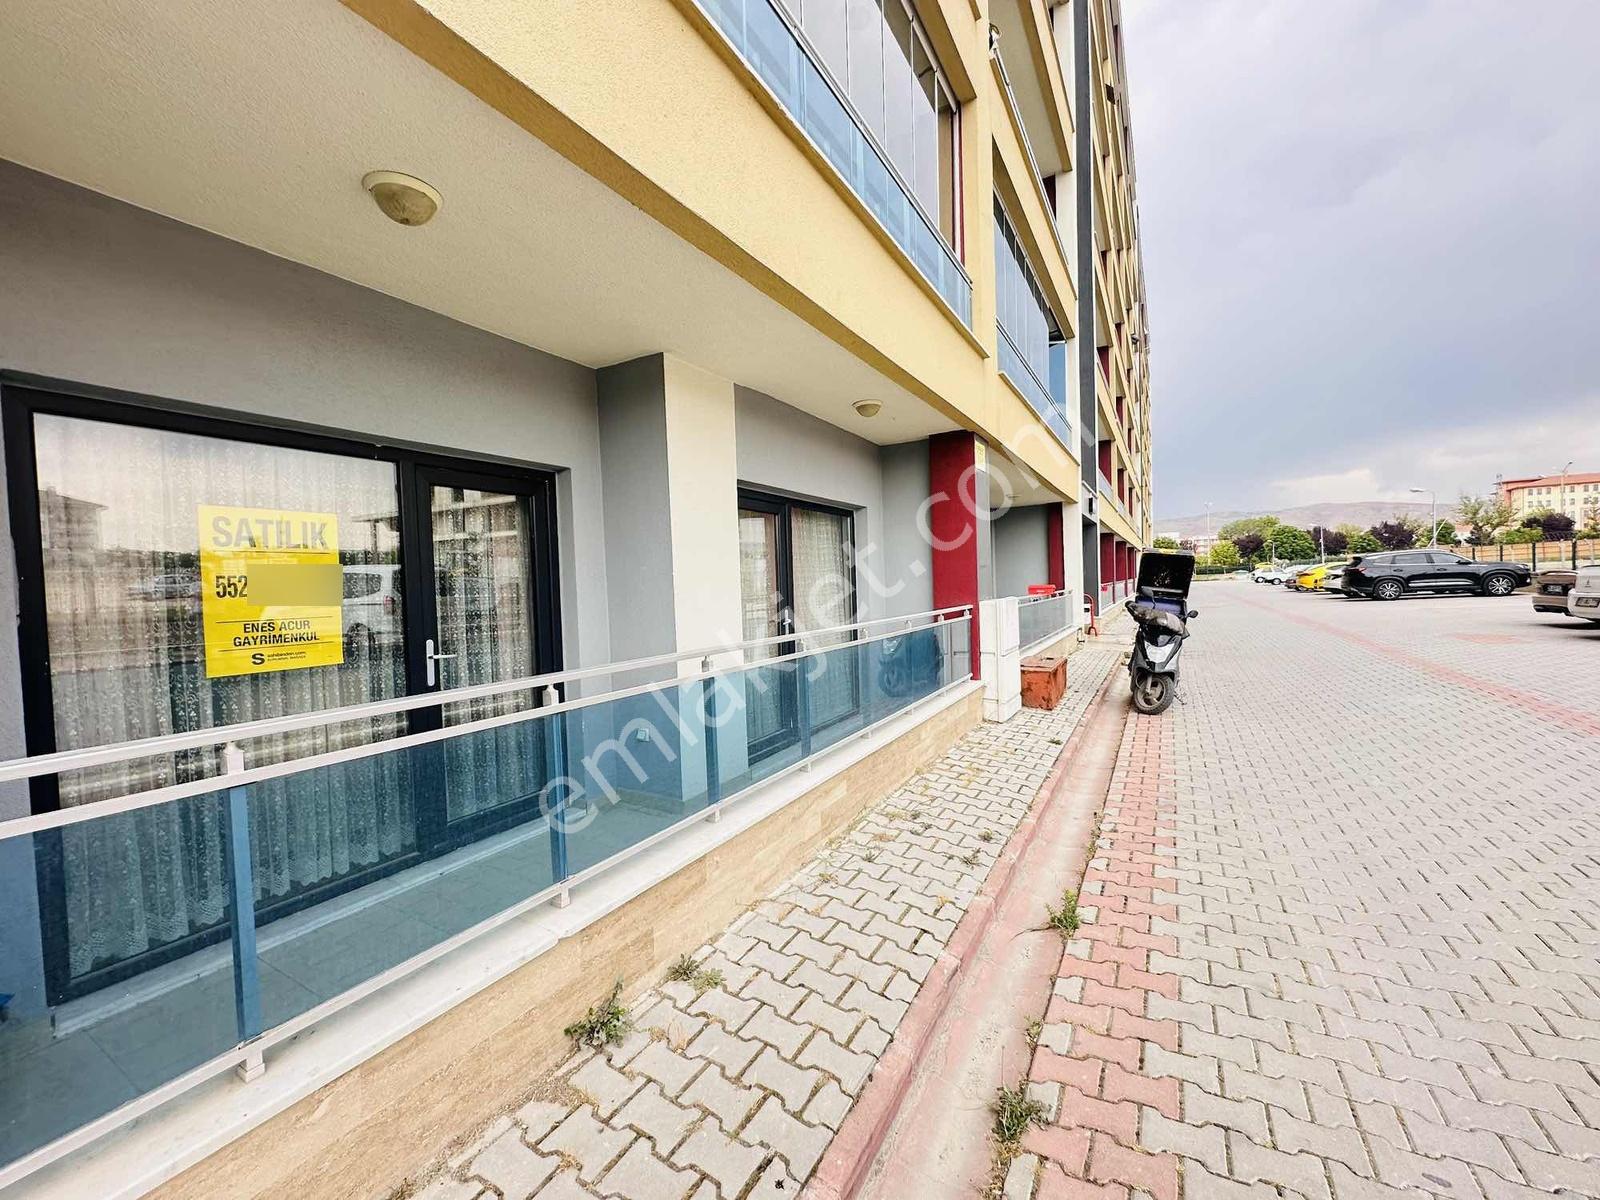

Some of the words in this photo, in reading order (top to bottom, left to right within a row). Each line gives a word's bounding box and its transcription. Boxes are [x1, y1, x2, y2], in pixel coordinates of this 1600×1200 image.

[212, 516, 327, 550] SATILIK
[215, 575, 248, 598] 552
[243, 621, 275, 633] ENES
[279, 620, 310, 631] ACUR
[233, 631, 319, 647] GAYRİMENKUL
